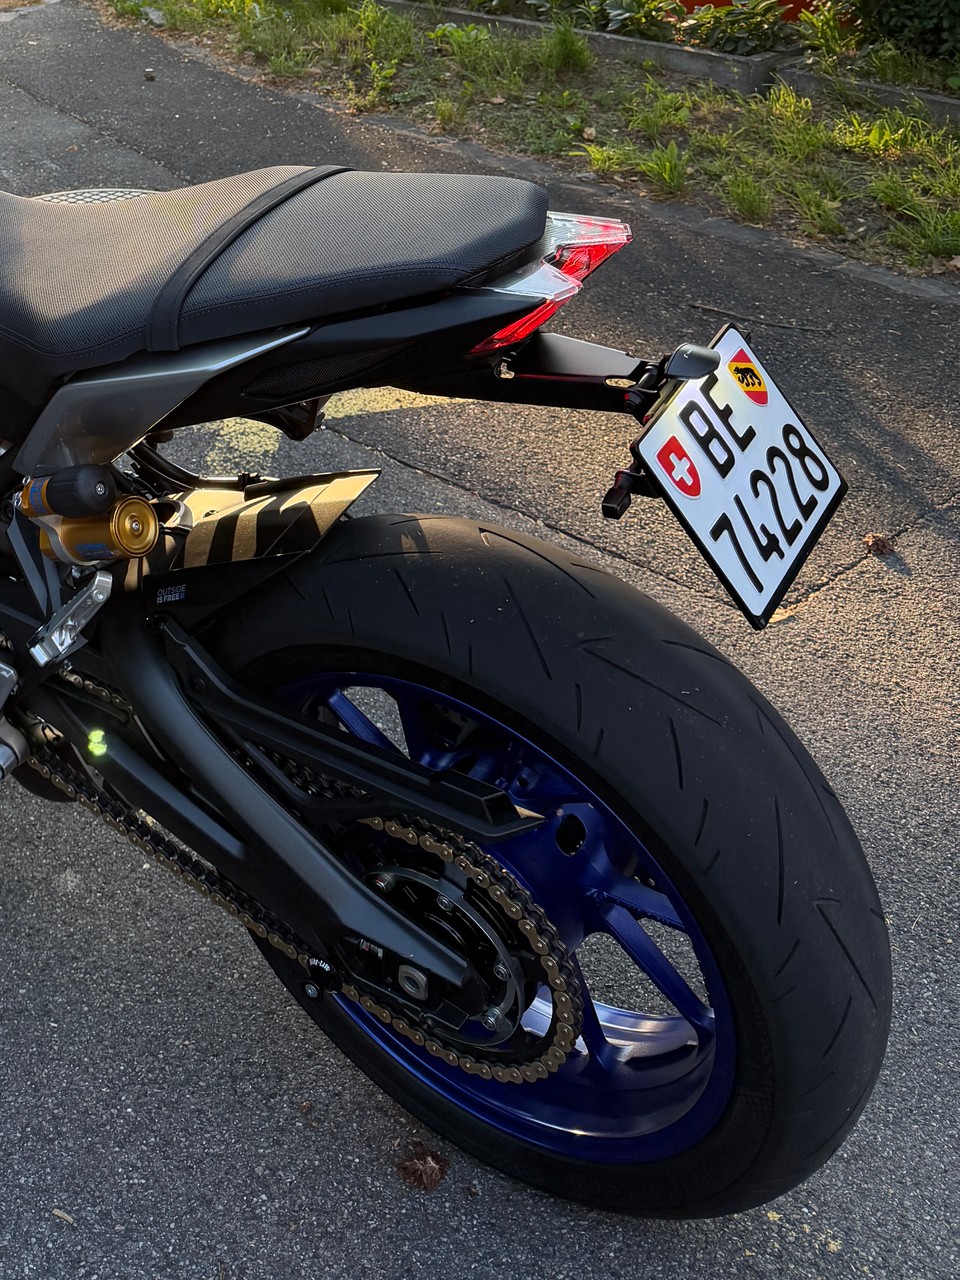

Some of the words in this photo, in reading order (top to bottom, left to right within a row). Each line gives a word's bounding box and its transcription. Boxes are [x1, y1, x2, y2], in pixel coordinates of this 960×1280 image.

[678, 372, 757, 480] BE
[709, 423, 830, 594] 74228
[156, 596, 163, 605] IS
[163, 592, 180, 603] FREE
[157, 583, 187, 597] OUTSIDE
